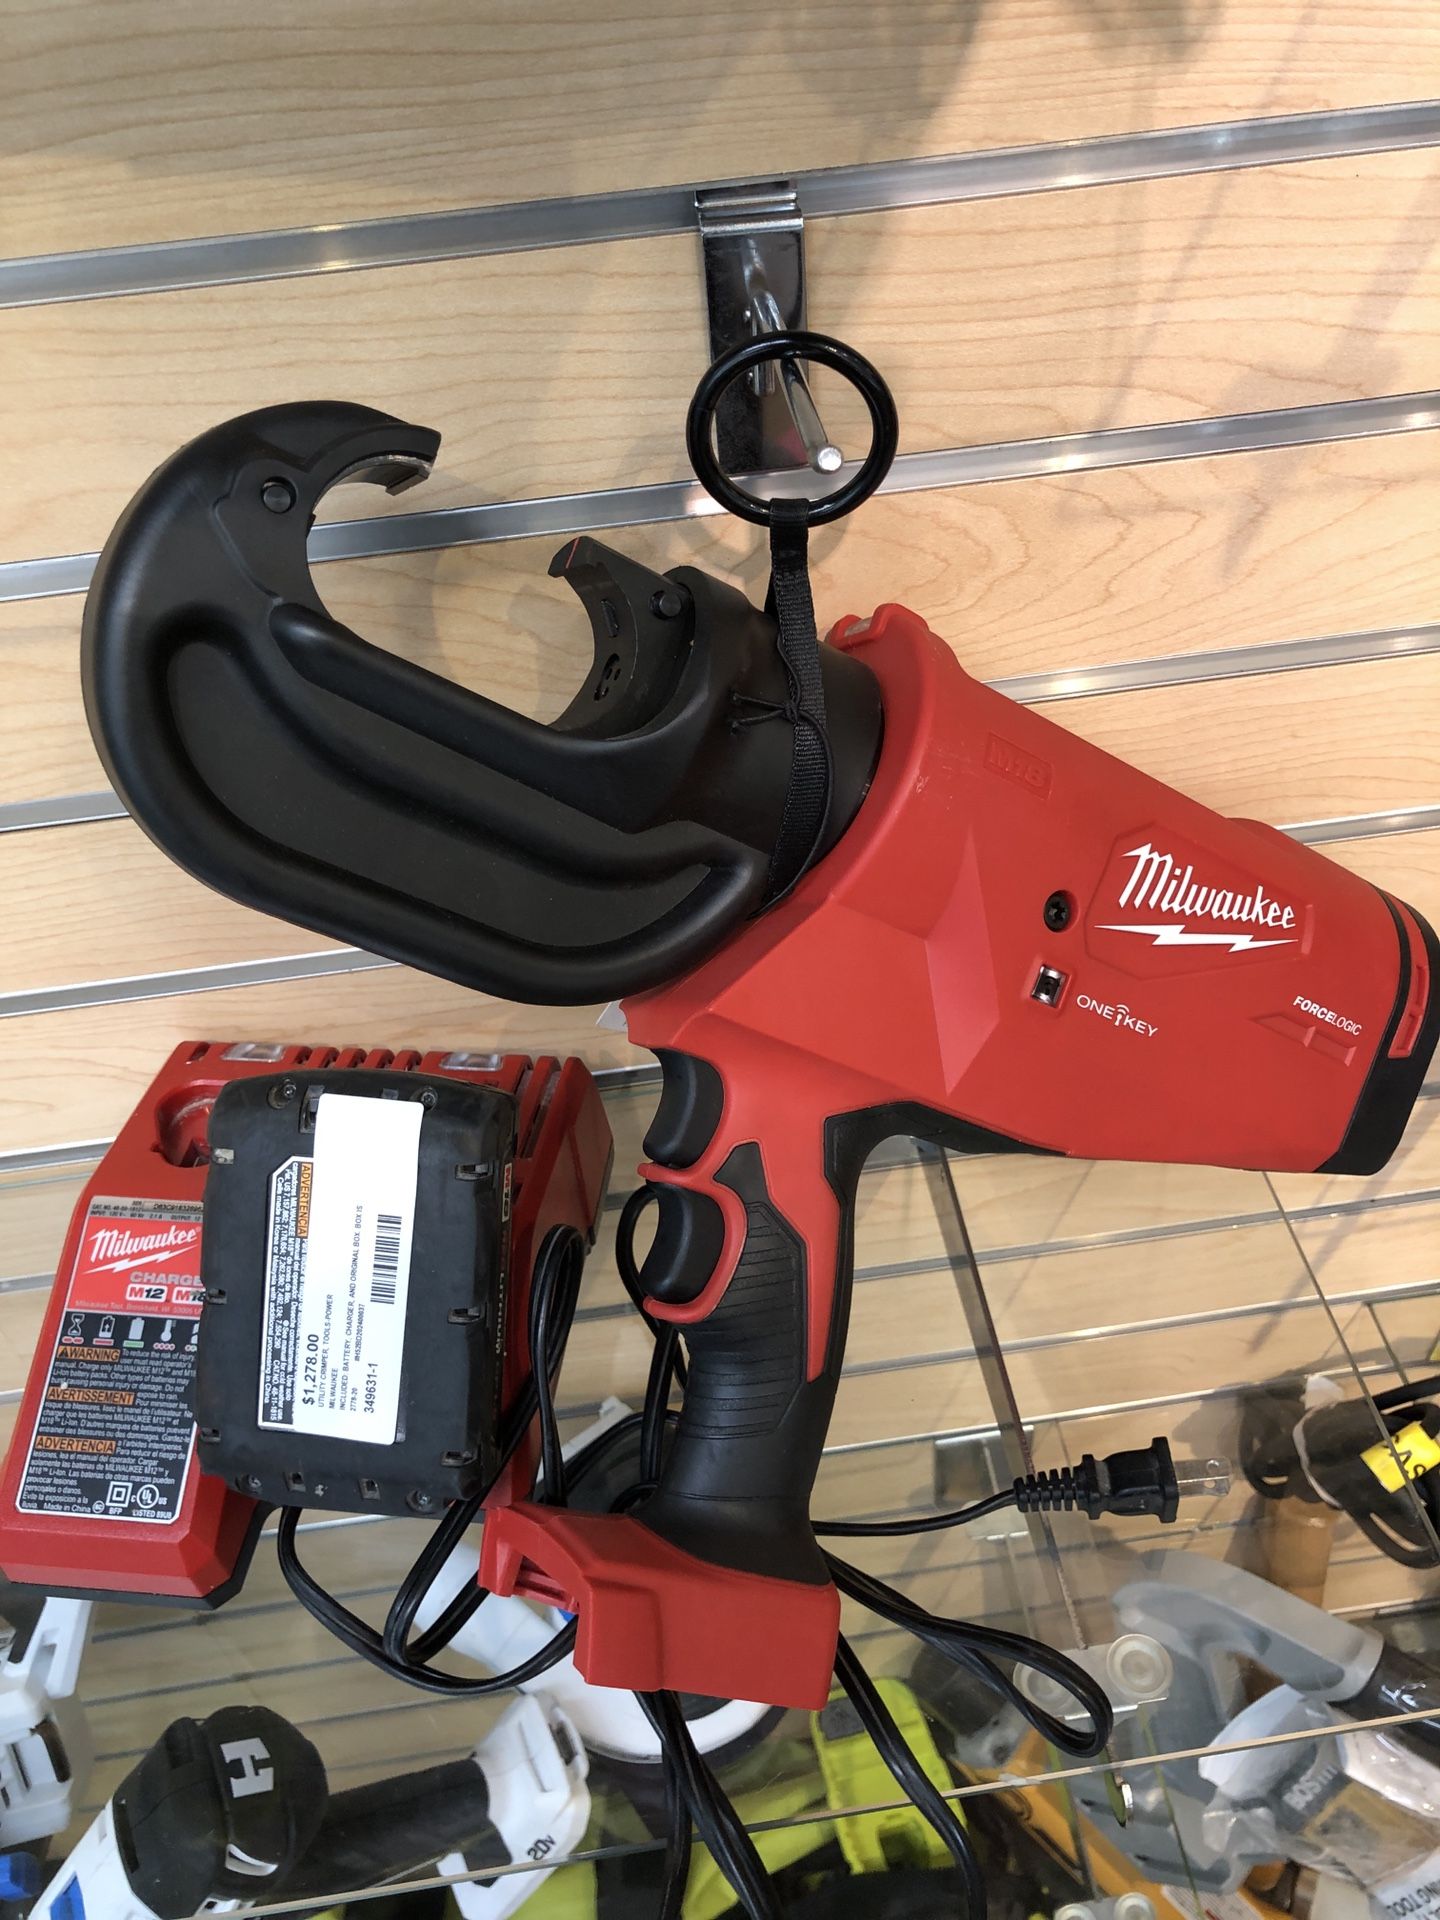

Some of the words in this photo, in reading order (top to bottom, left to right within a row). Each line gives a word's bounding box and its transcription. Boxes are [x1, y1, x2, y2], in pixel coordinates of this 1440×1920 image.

[1119, 842, 1296, 931] Milwaukee
[1293, 996, 1362, 1036] FORCELOGIC
[298, 1165, 311, 1235] ADVERTENCIA
[128, 1286, 165, 1299] M12
[68, 1347, 120, 1361] WARNING
[302, 1334, 320, 1405] $1,278.00
[48, 1387, 133, 1404] AVERTISSEMENT
[317, 1382, 326, 1407] UTILITY
[329, 1367, 338, 1409] MILWAUKEE
[364, 1363, 378, 1413] 349631-1
[36, 1437, 115, 1453] ADVERTENCIA
